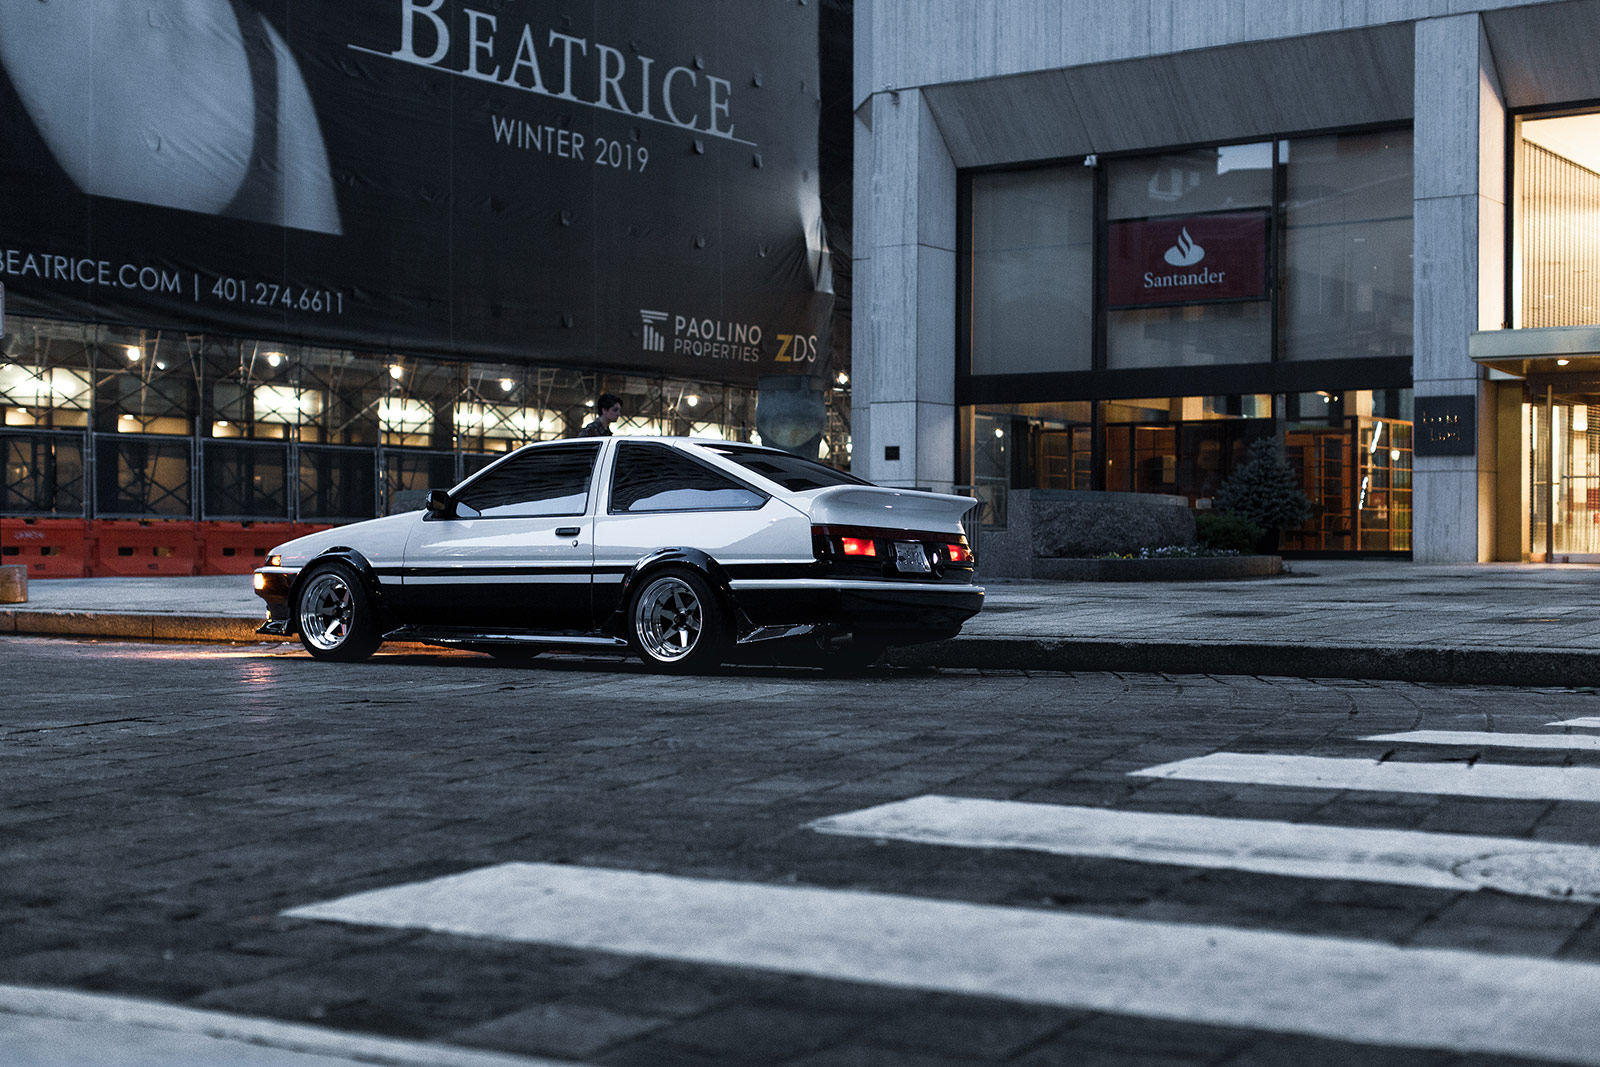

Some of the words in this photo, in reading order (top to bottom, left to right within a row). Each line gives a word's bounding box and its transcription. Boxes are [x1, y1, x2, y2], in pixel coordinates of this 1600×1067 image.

[391, 0, 735, 139] BEATRICE
[491, 114, 585, 161] WINTER
[594, 137, 650, 174] 2019
[1143, 266, 1226, 289] Santander
[211, 277, 343, 314] 401.274.6611
[674, 314, 762, 346] PAOLINO
[673, 337, 760, 363] PROPERTIES
[774, 333, 819, 364] ZDS
